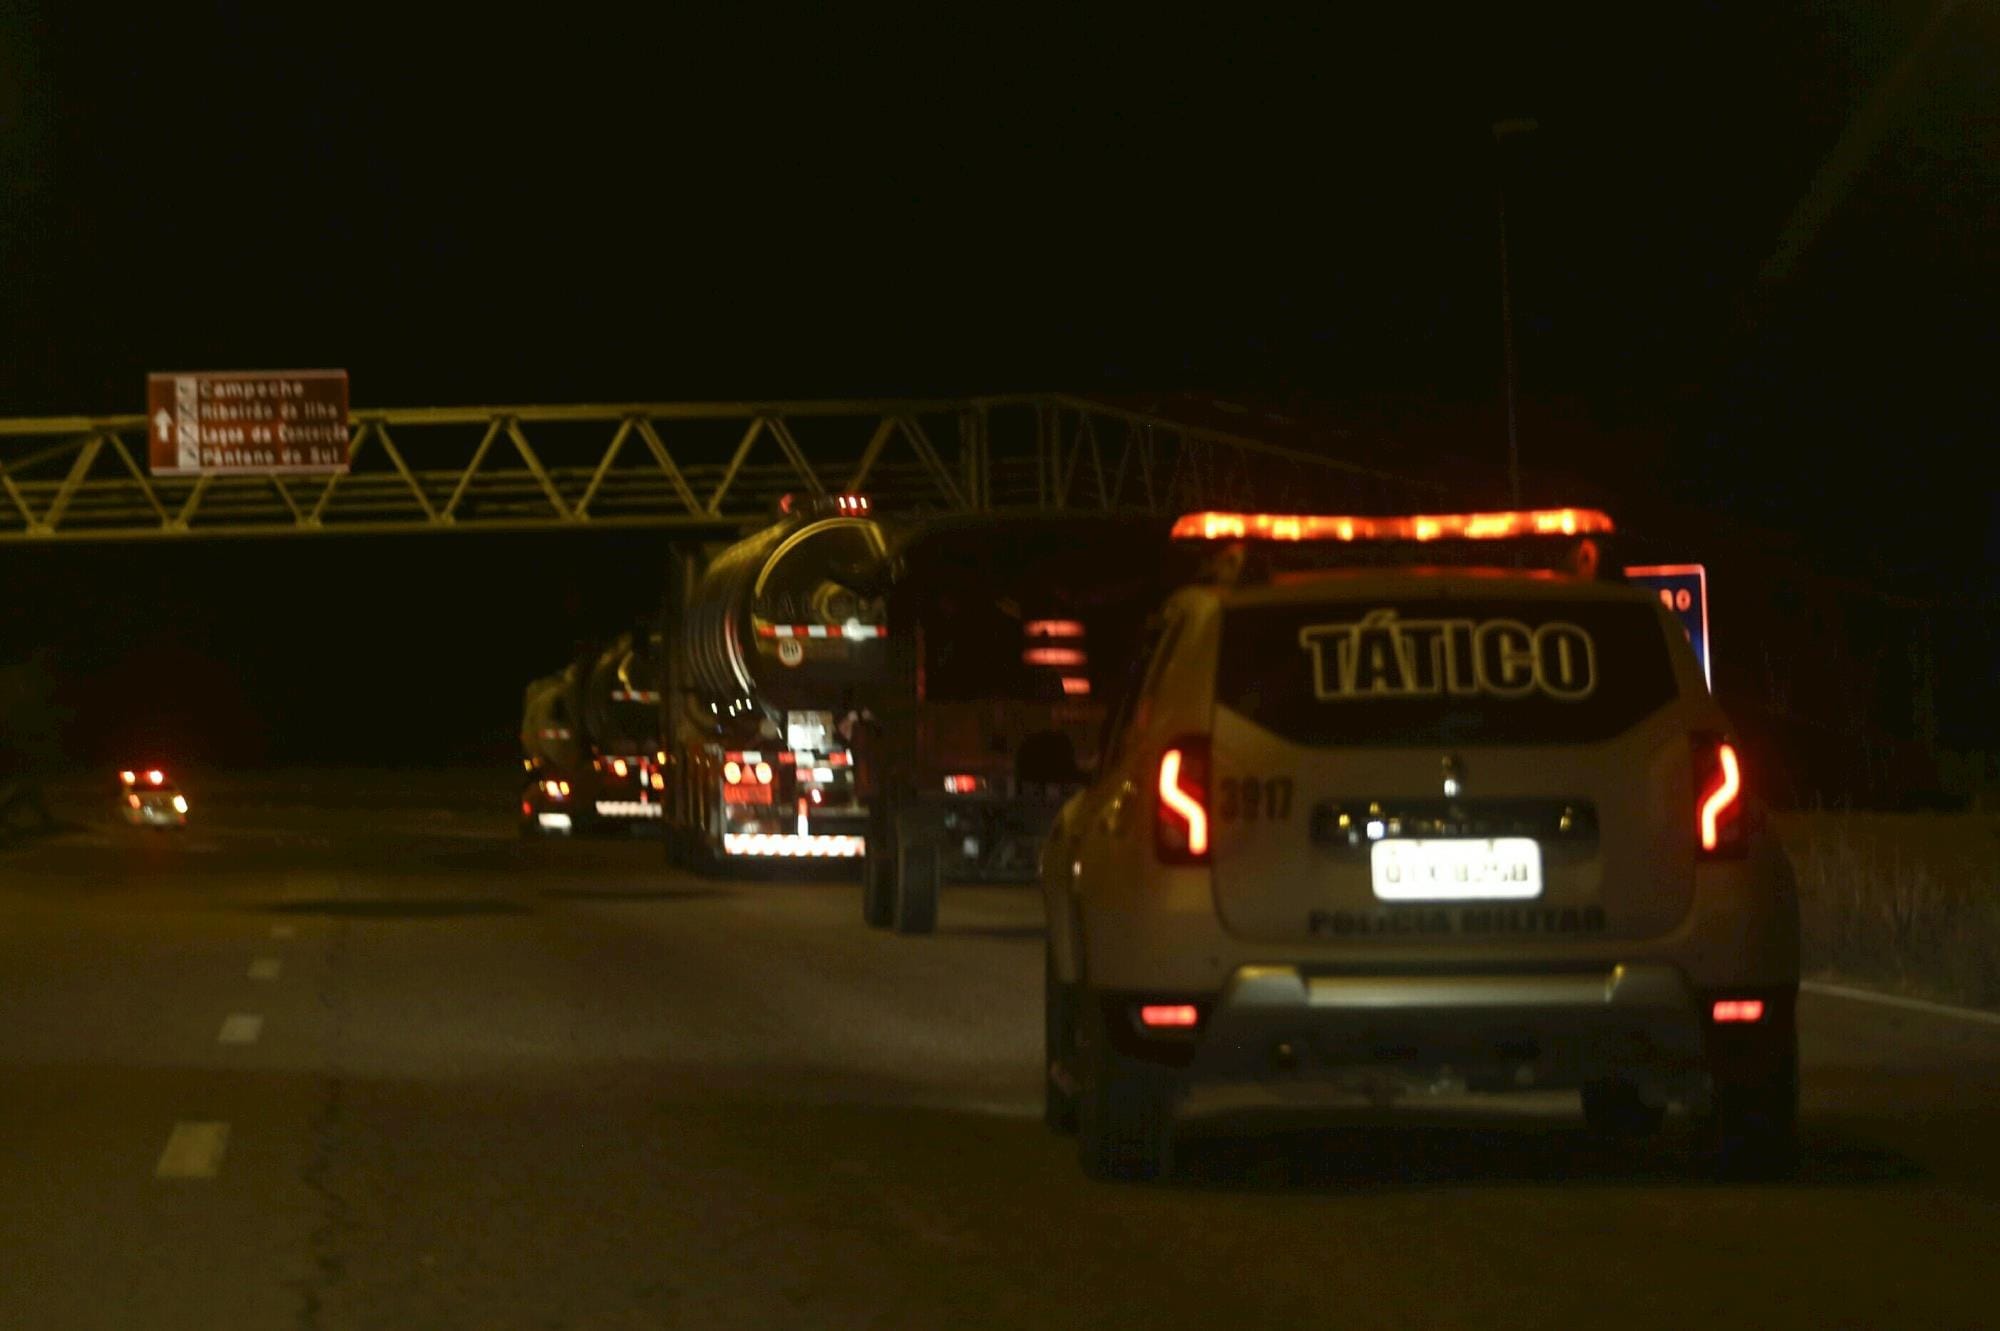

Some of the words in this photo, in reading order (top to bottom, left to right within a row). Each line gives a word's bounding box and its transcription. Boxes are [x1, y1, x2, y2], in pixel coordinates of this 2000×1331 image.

[201, 379, 304, 399] Campeche
[1299, 608, 1597, 700] TÁTICO
[1461, 906, 1606, 934] MILITAR
